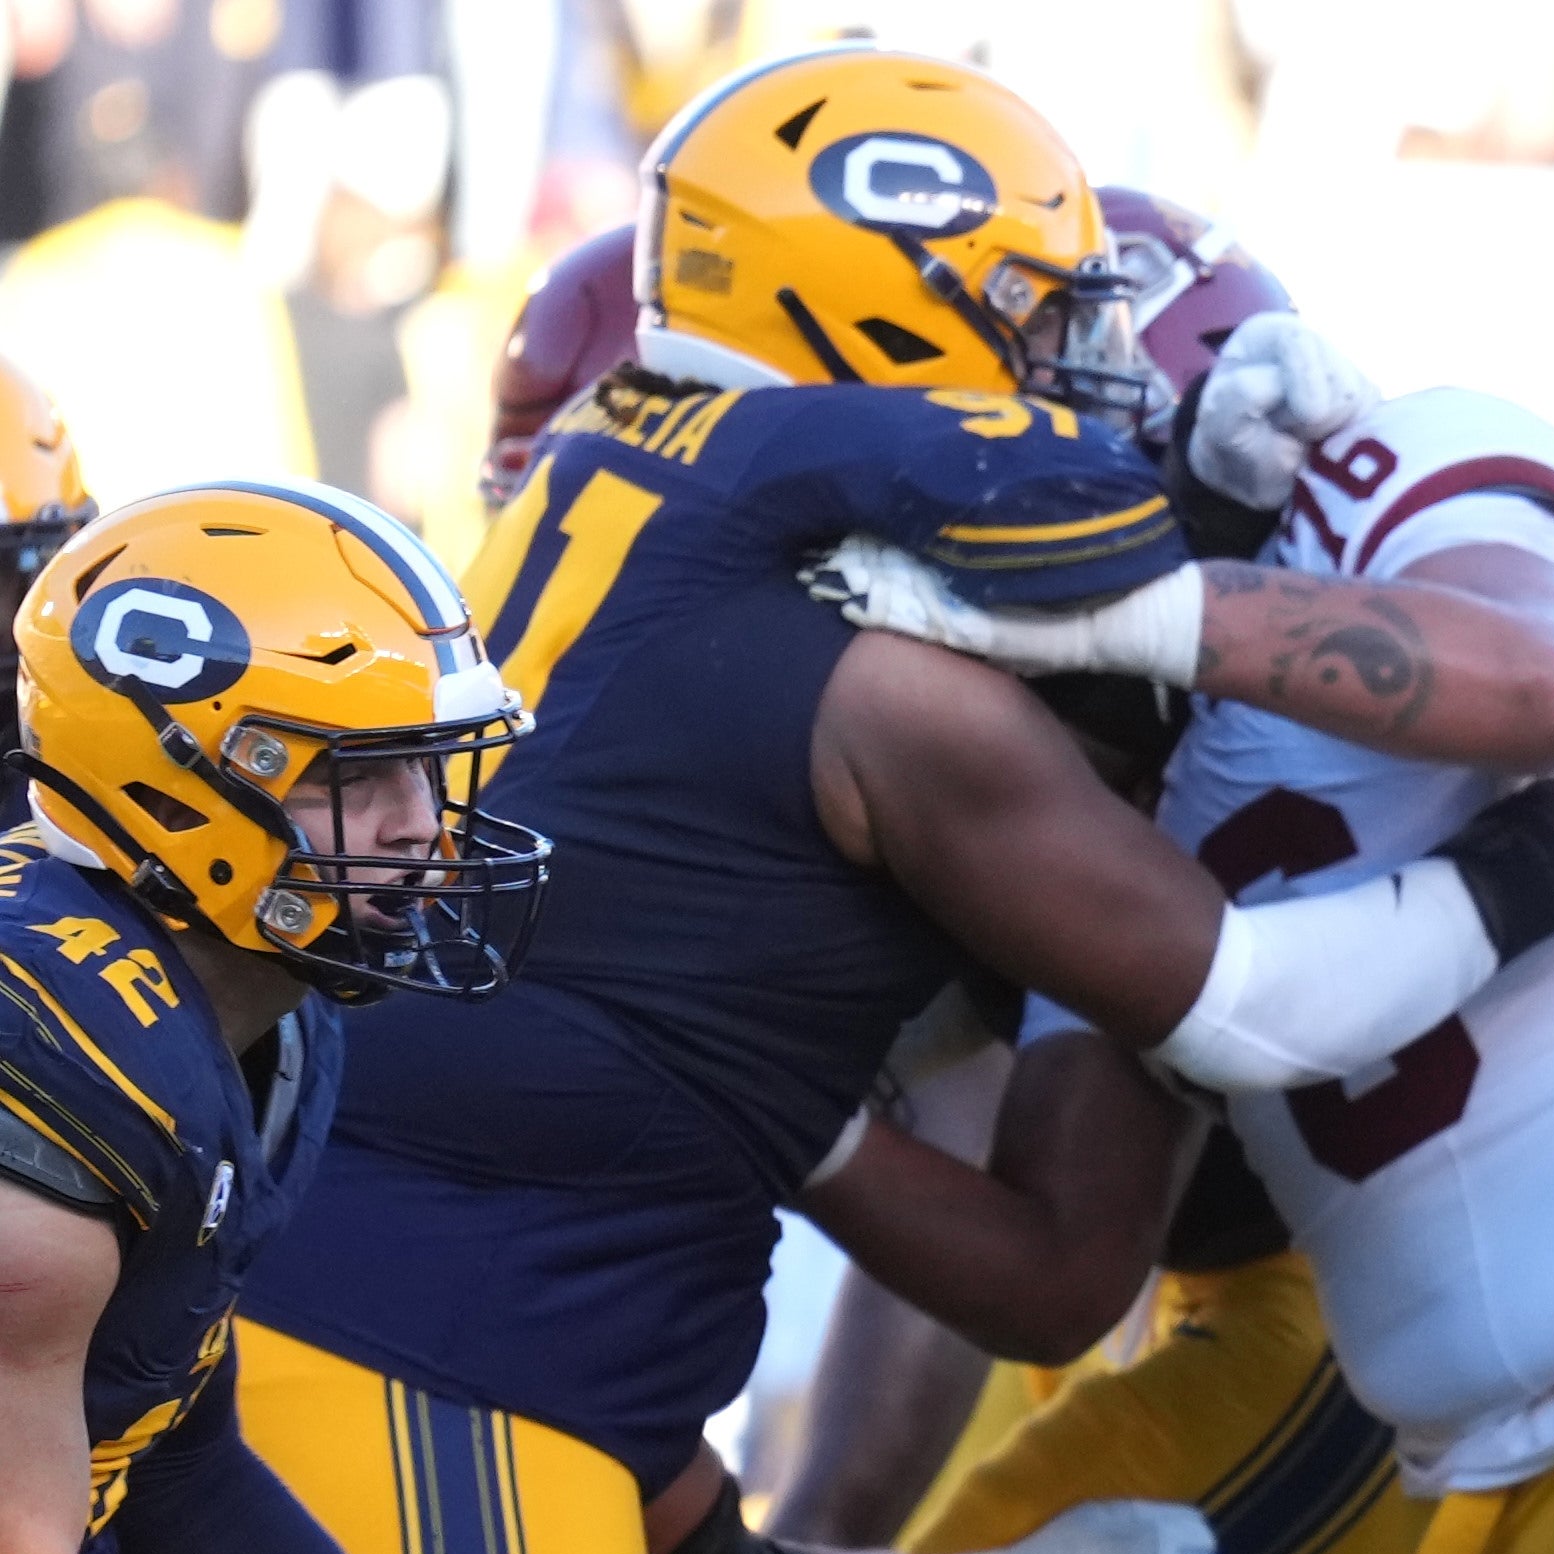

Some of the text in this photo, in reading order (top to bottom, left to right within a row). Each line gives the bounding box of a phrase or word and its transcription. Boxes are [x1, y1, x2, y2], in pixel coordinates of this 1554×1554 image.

[843, 138, 963, 229] C
[1286, 437, 1399, 570] 76
[94, 588, 213, 689] C
[25, 916, 181, 1029] 42
